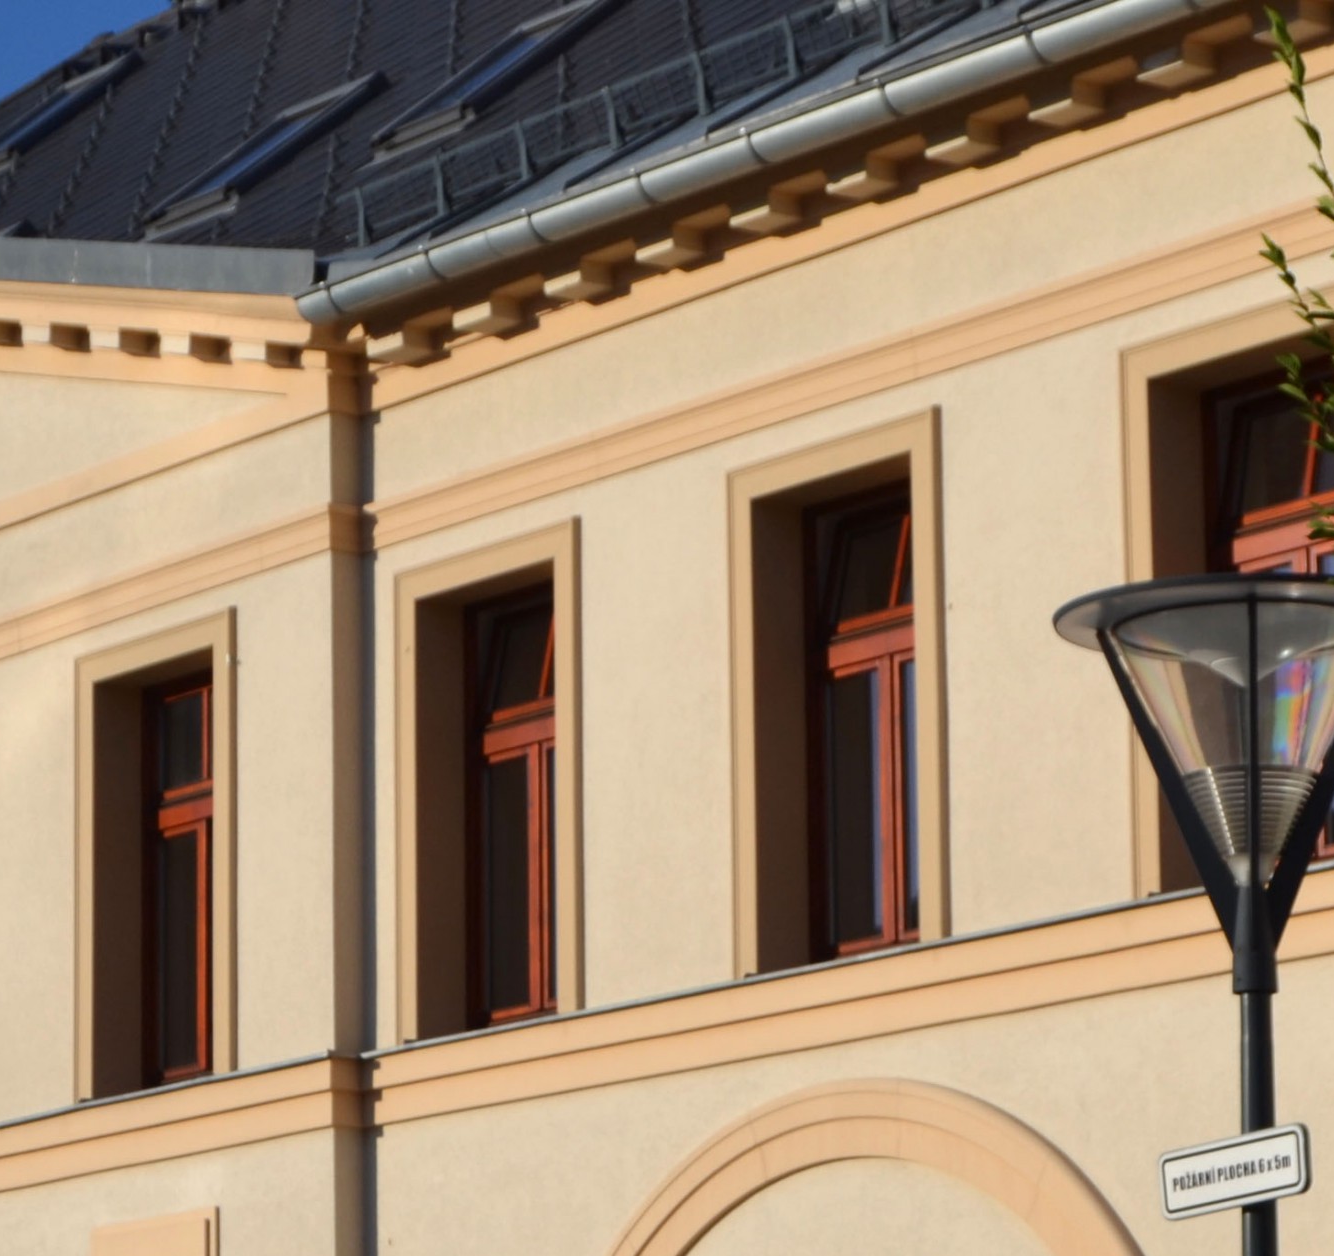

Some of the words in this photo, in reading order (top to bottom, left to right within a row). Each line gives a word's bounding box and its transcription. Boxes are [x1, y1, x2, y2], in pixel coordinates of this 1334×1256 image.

[1172, 1166, 1216, 1192] POŽÁRNÍ
[1217, 1160, 1258, 1182] PLOCHA
[1258, 1158, 1265, 1173] 6
